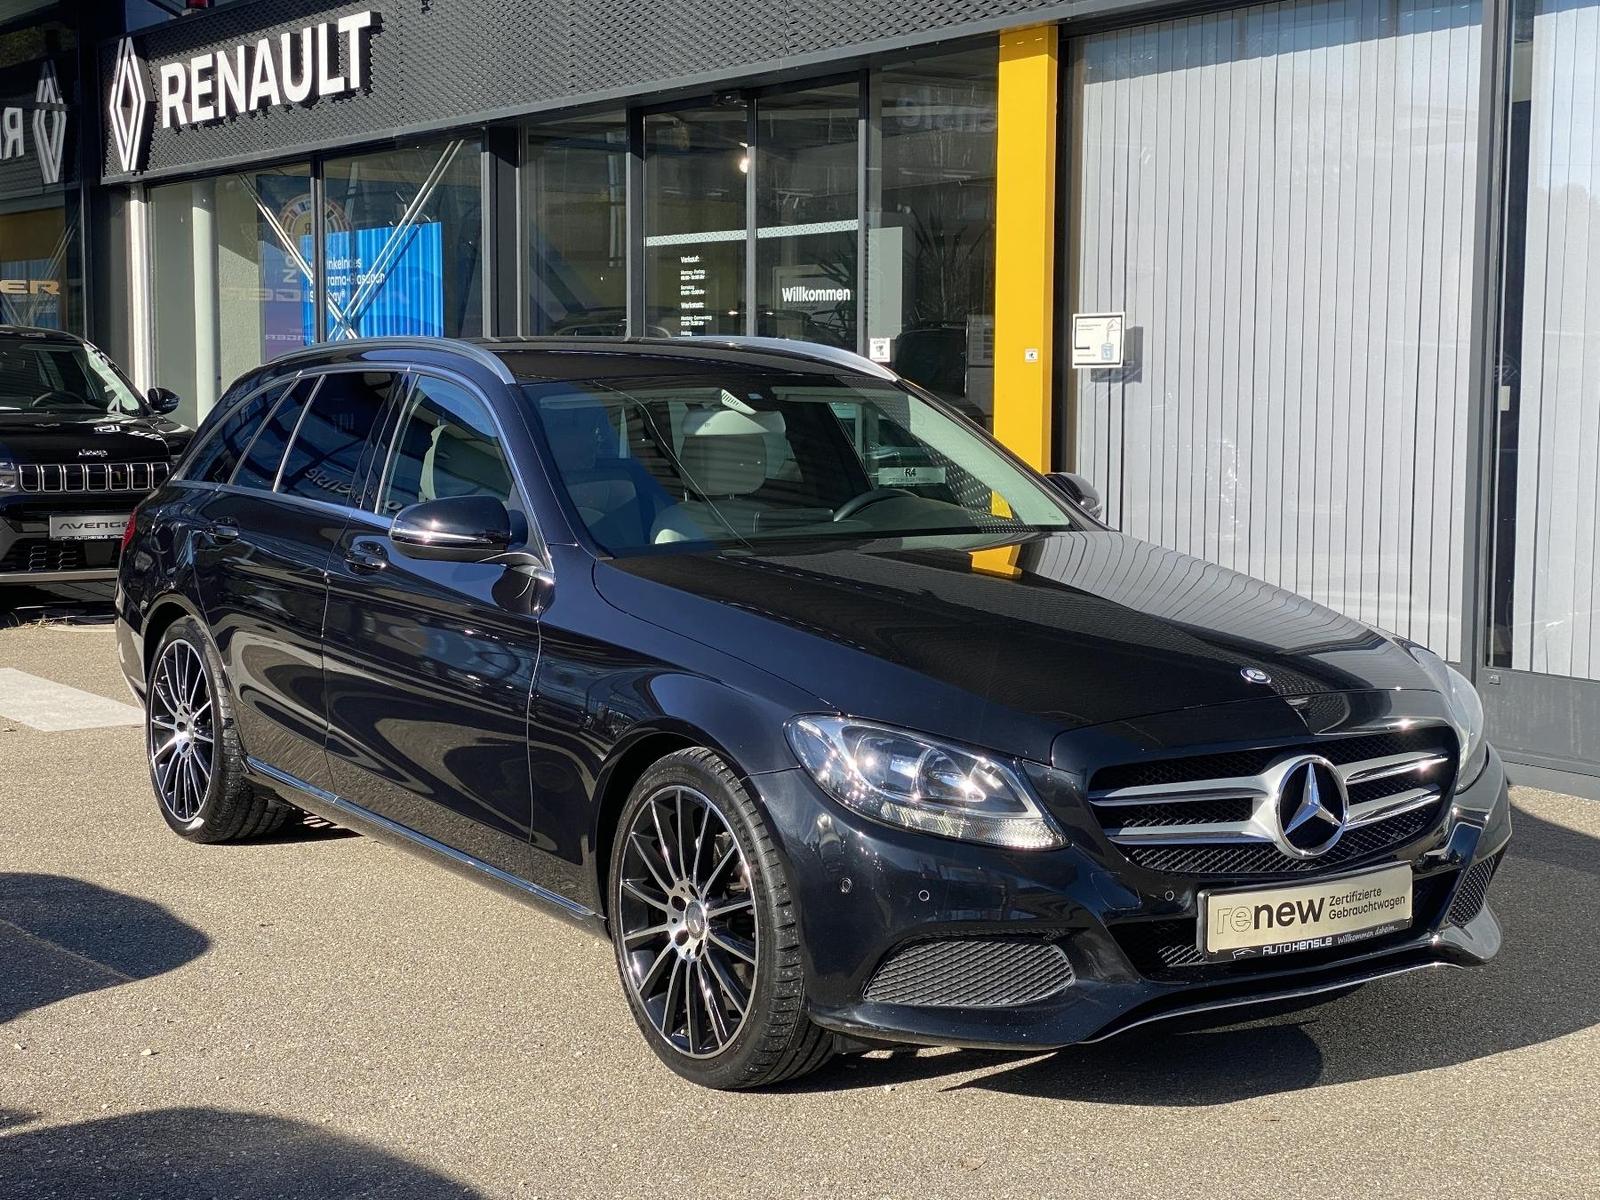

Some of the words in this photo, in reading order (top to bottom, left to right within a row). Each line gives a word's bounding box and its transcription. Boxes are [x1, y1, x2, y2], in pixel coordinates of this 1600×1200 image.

[160, 10, 371, 128] RENAULT
[782, 285, 851, 302] Willkommen
[1328, 895, 1406, 920] Gebrauchtwagen
[1329, 887, 1382, 907] Zertifizierte
[1216, 897, 1325, 935] renew
